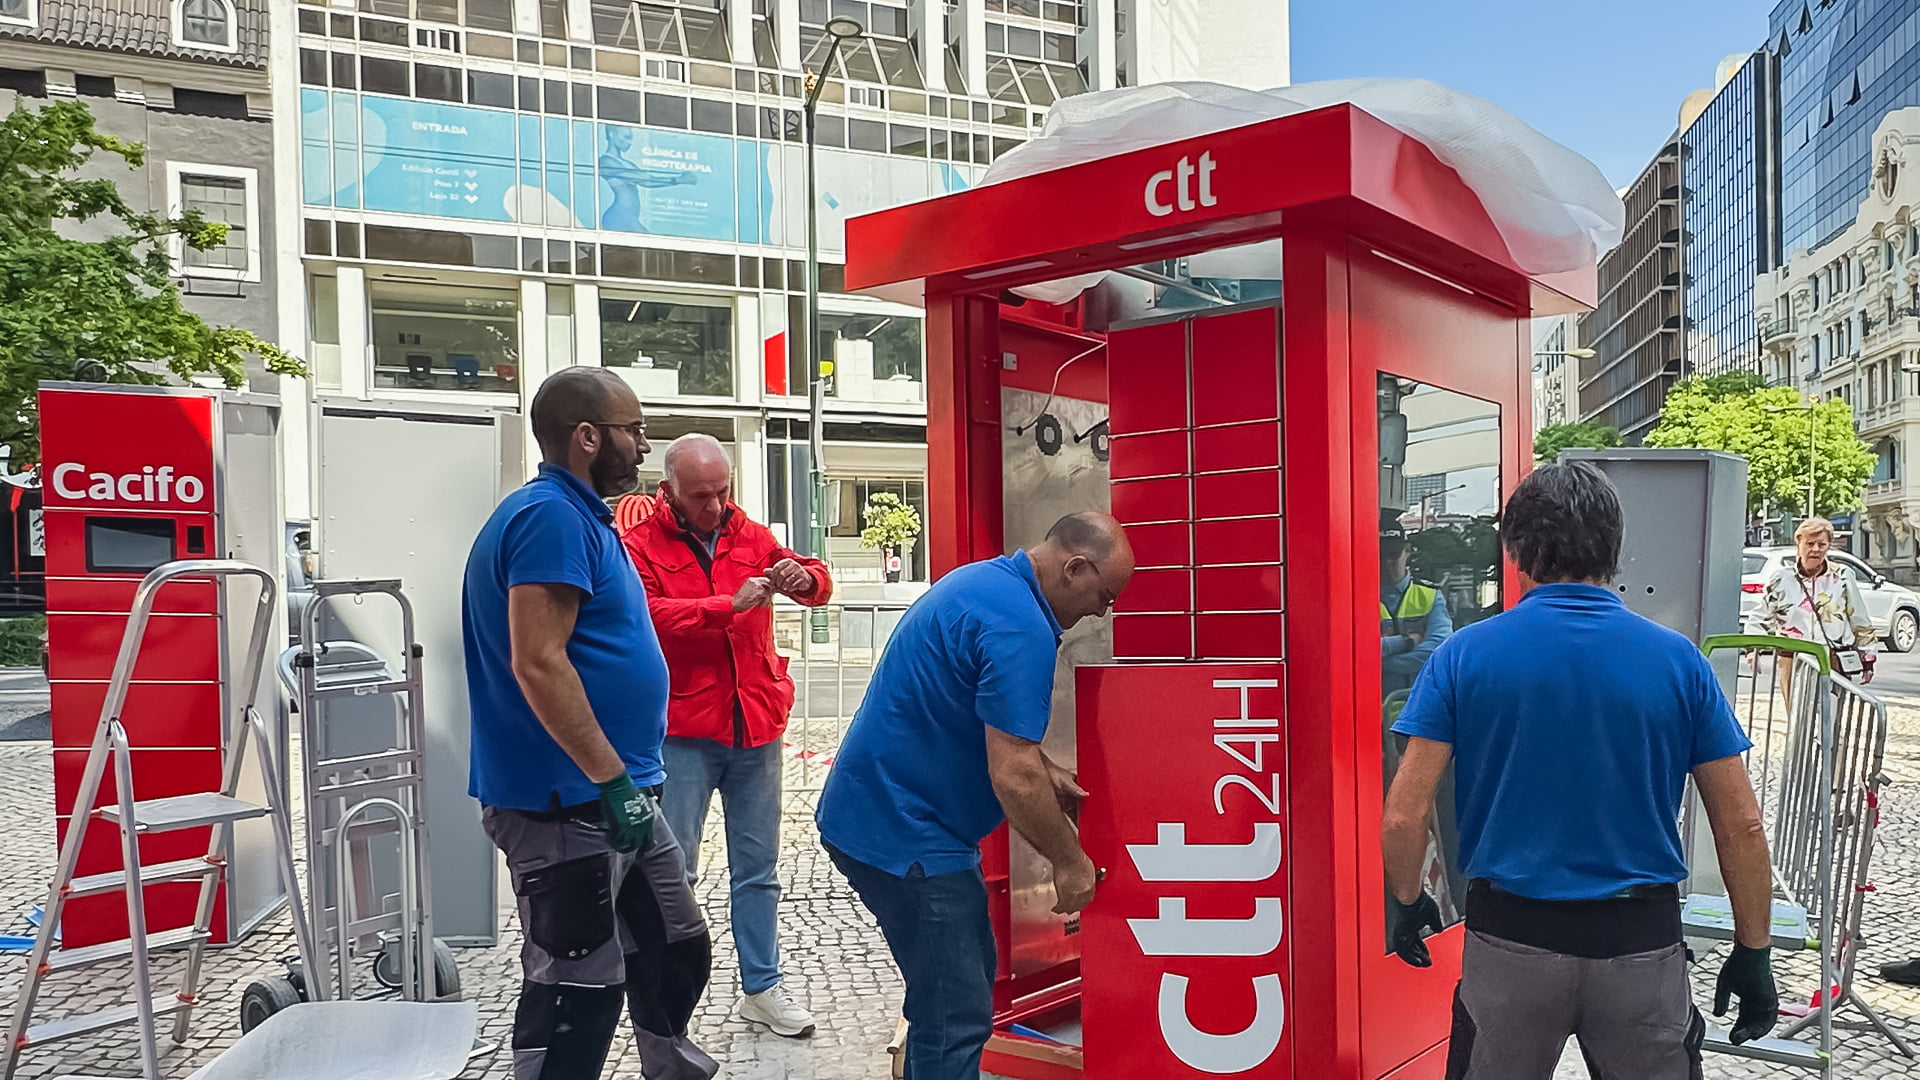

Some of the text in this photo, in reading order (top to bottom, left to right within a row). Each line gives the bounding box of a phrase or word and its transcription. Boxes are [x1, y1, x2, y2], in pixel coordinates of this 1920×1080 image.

[412, 121, 468, 135] ENTRADA
[641, 146, 699, 161] CLÍNICA DE
[641, 158, 712, 173] FISIOTERAPIA
[1144, 150, 1218, 217] ctt
[52, 462, 205, 503] Cacifo
[1125, 679, 1285, 1074] ctt 24H
